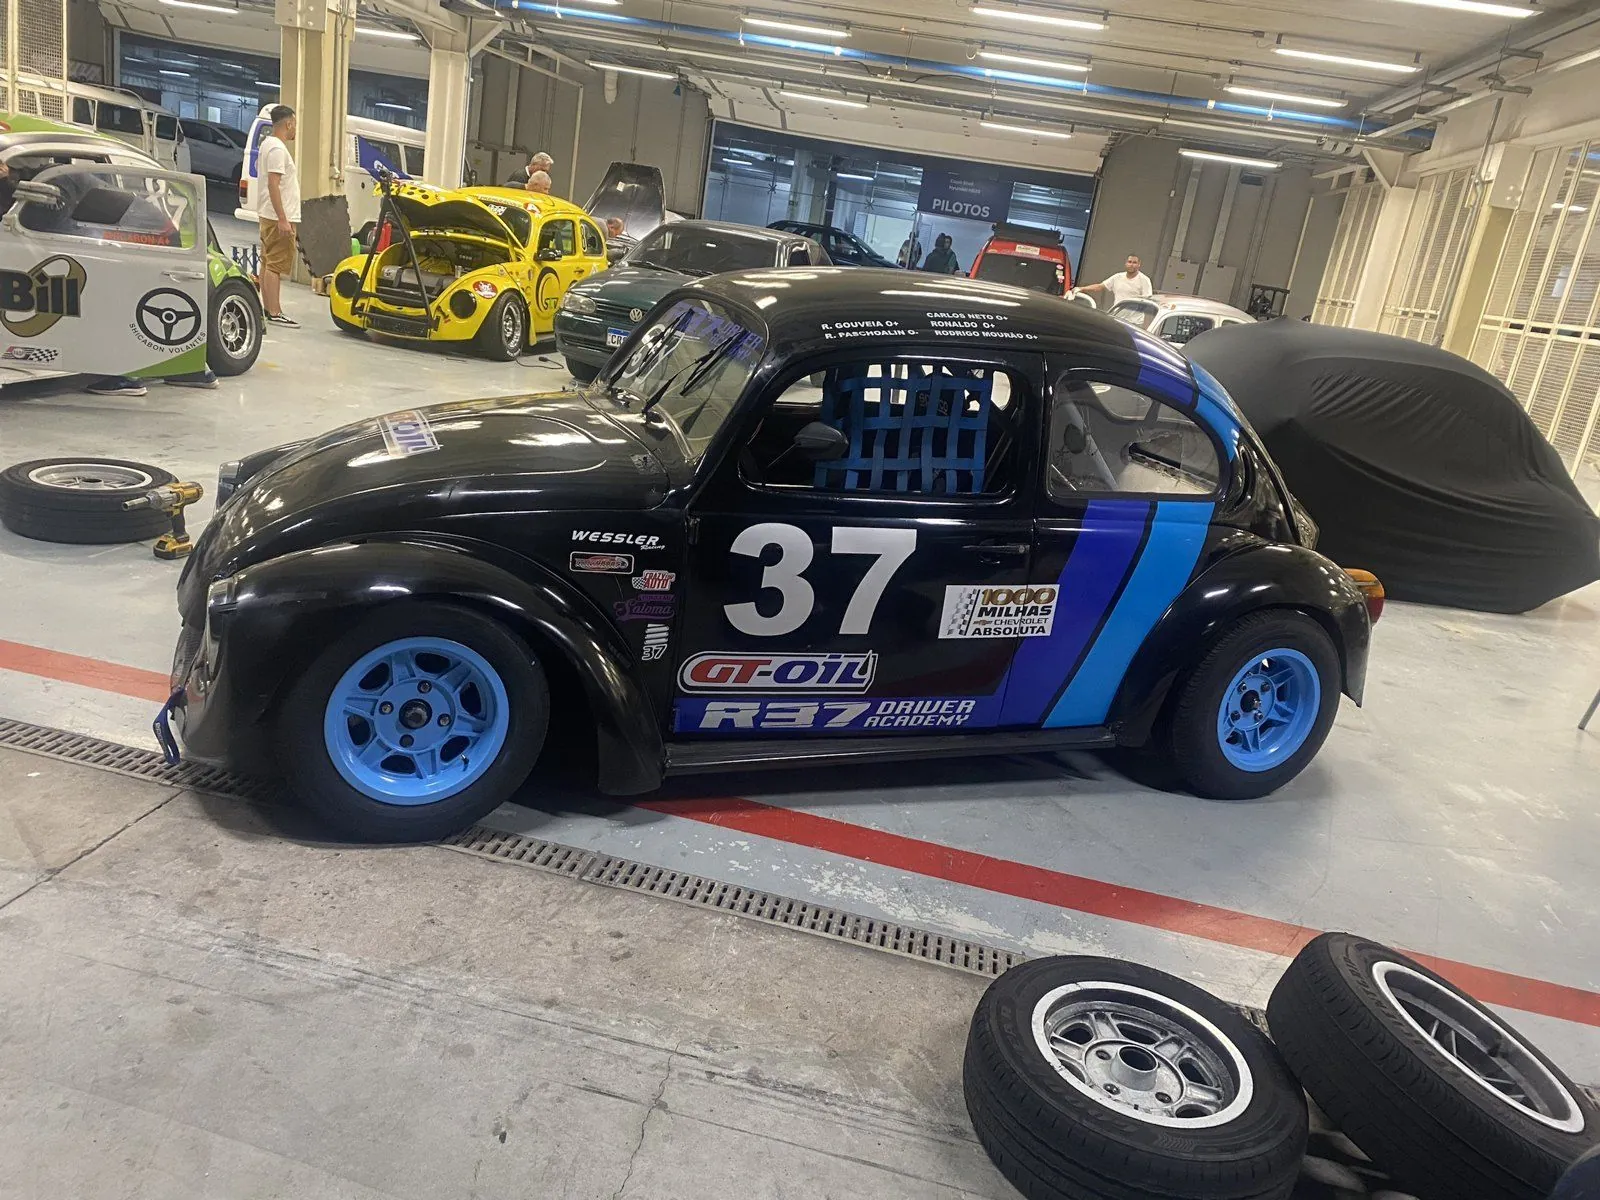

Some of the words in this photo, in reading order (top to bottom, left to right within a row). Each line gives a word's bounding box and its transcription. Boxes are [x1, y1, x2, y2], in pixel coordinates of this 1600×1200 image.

[932, 198, 990, 217] PILOTOS
[0, 269, 81, 318] Bill
[835, 321, 884, 329] GOUVEIA
[129, 323, 165, 352] SHICABON
[169, 331, 206, 354] VOLANTES
[838, 330, 906, 338] PASCHOALIN
[982, 331, 1024, 339] MOURÃO
[571, 530, 660, 545] WESSLER
[723, 522, 917, 636] 37
[981, 588, 1056, 606] 1000
[978, 606, 1053, 617] MILHAS
[994, 617, 1049, 625] CHEVROLET
[971, 626, 1046, 636] ABSOLUTA
[641, 644, 667, 660] 37
[876, 700, 976, 714] DRIVER
[699, 701, 871, 728] R37
[864, 714, 970, 727] ACADEMY
